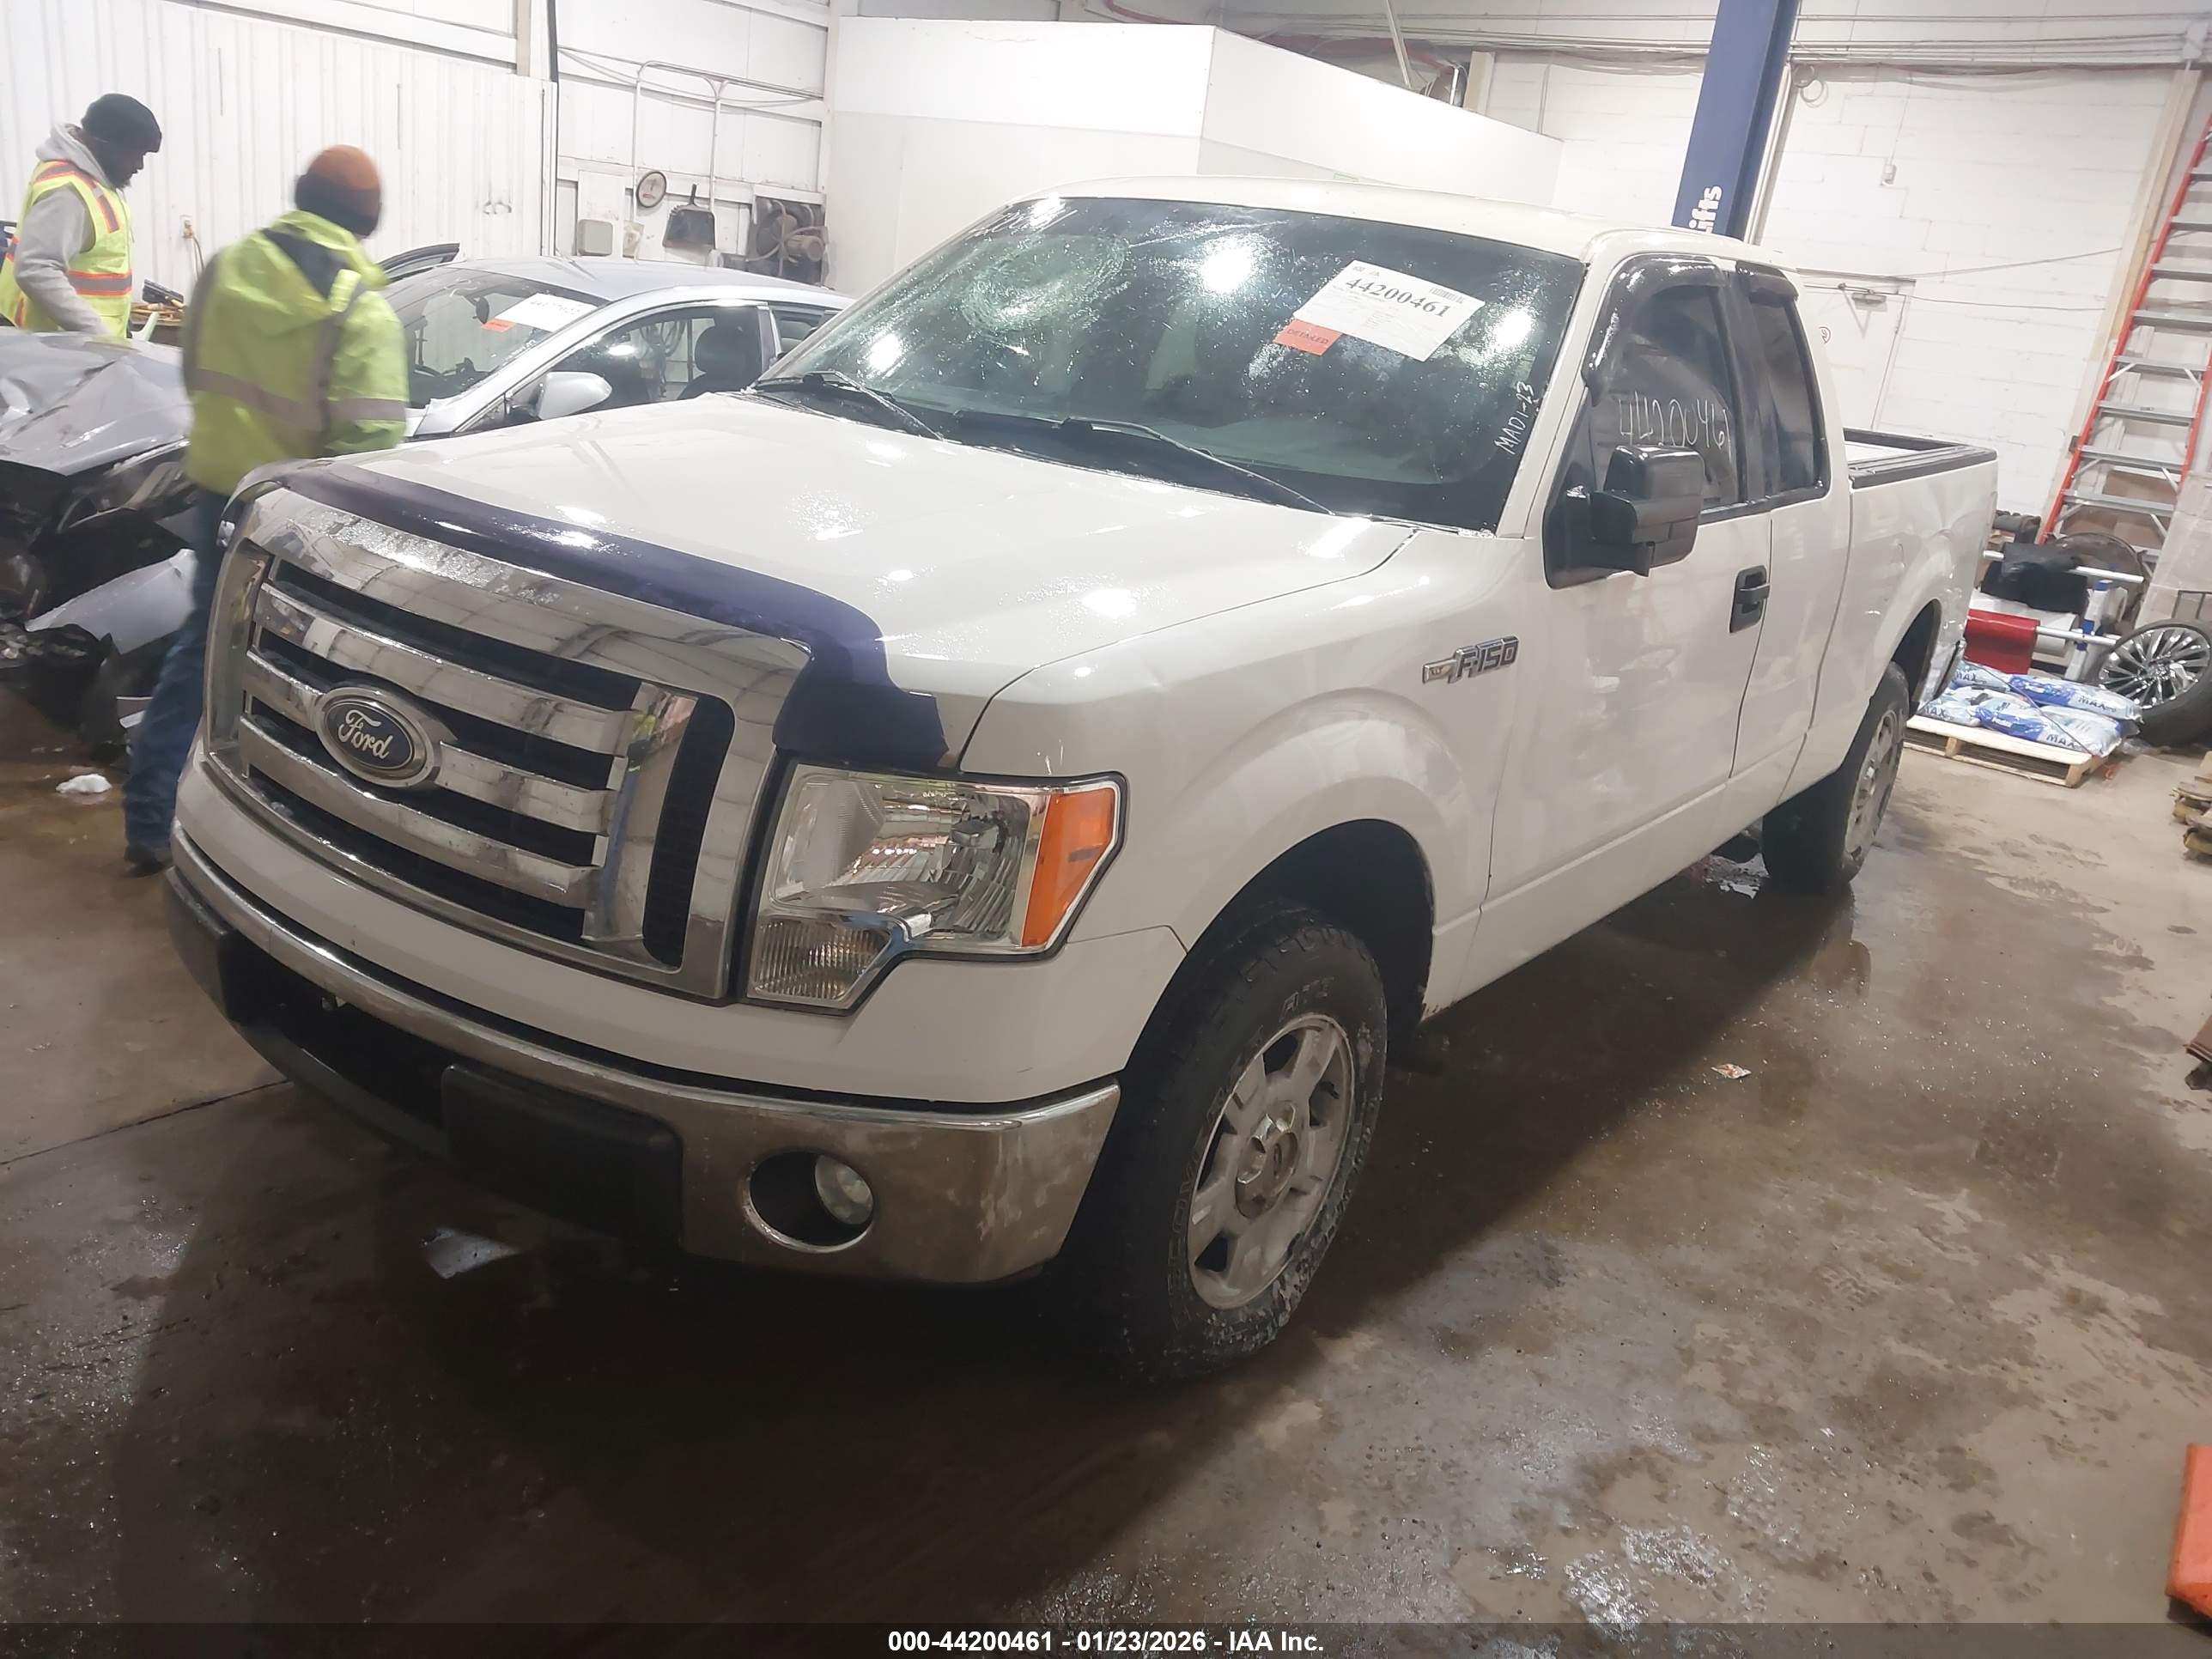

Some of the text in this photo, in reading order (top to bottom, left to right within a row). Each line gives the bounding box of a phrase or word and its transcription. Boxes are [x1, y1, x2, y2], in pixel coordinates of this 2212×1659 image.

[1688, 185, 1723, 233] ifts
[1346, 277, 1450, 318] 44200461
[337, 709, 393, 759] Ford
